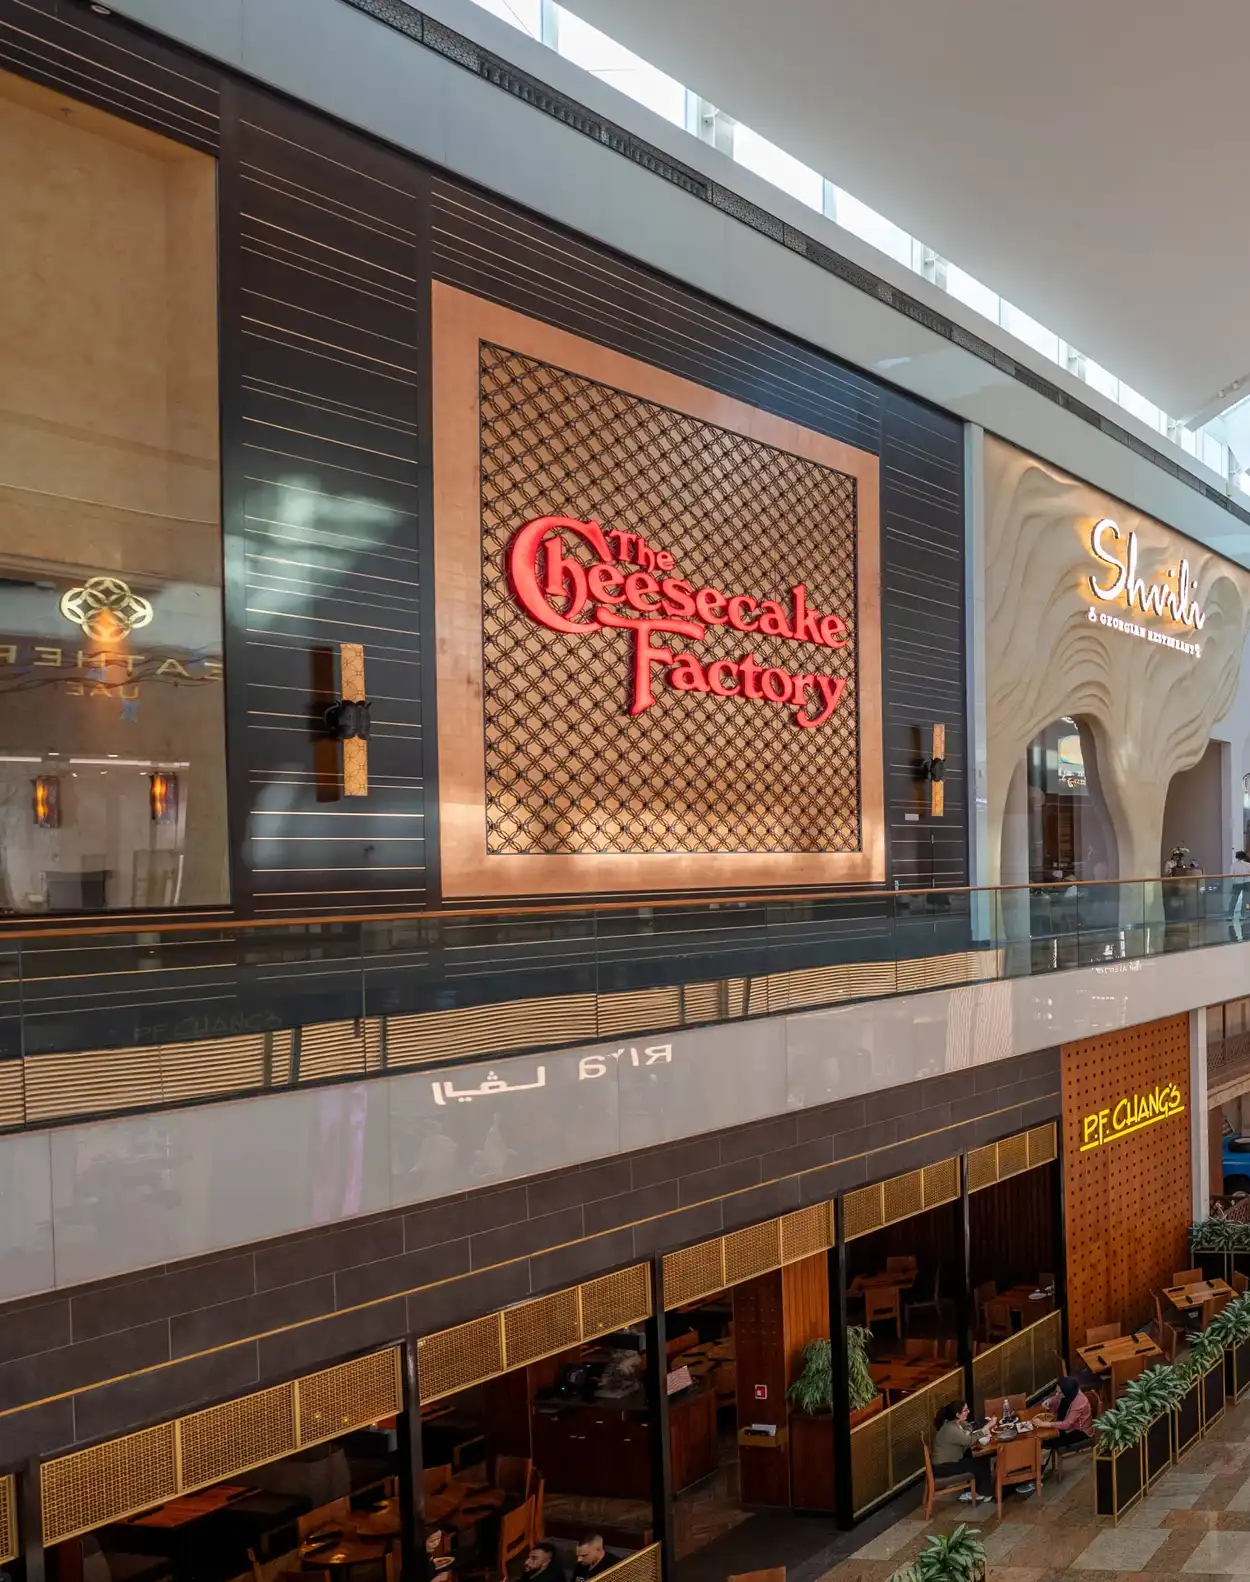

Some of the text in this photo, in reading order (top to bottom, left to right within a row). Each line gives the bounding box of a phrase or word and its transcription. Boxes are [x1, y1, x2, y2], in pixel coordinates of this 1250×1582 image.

[507, 515, 850, 649] Cheesecake
[609, 527, 675, 573] The
[1088, 518, 1206, 630] Shvili
[596, 604, 847, 729] Factory
[1100, 613, 1146, 639] GEORGIAN
[1084, 1082, 1181, 1145] P.F. CHANG'S
